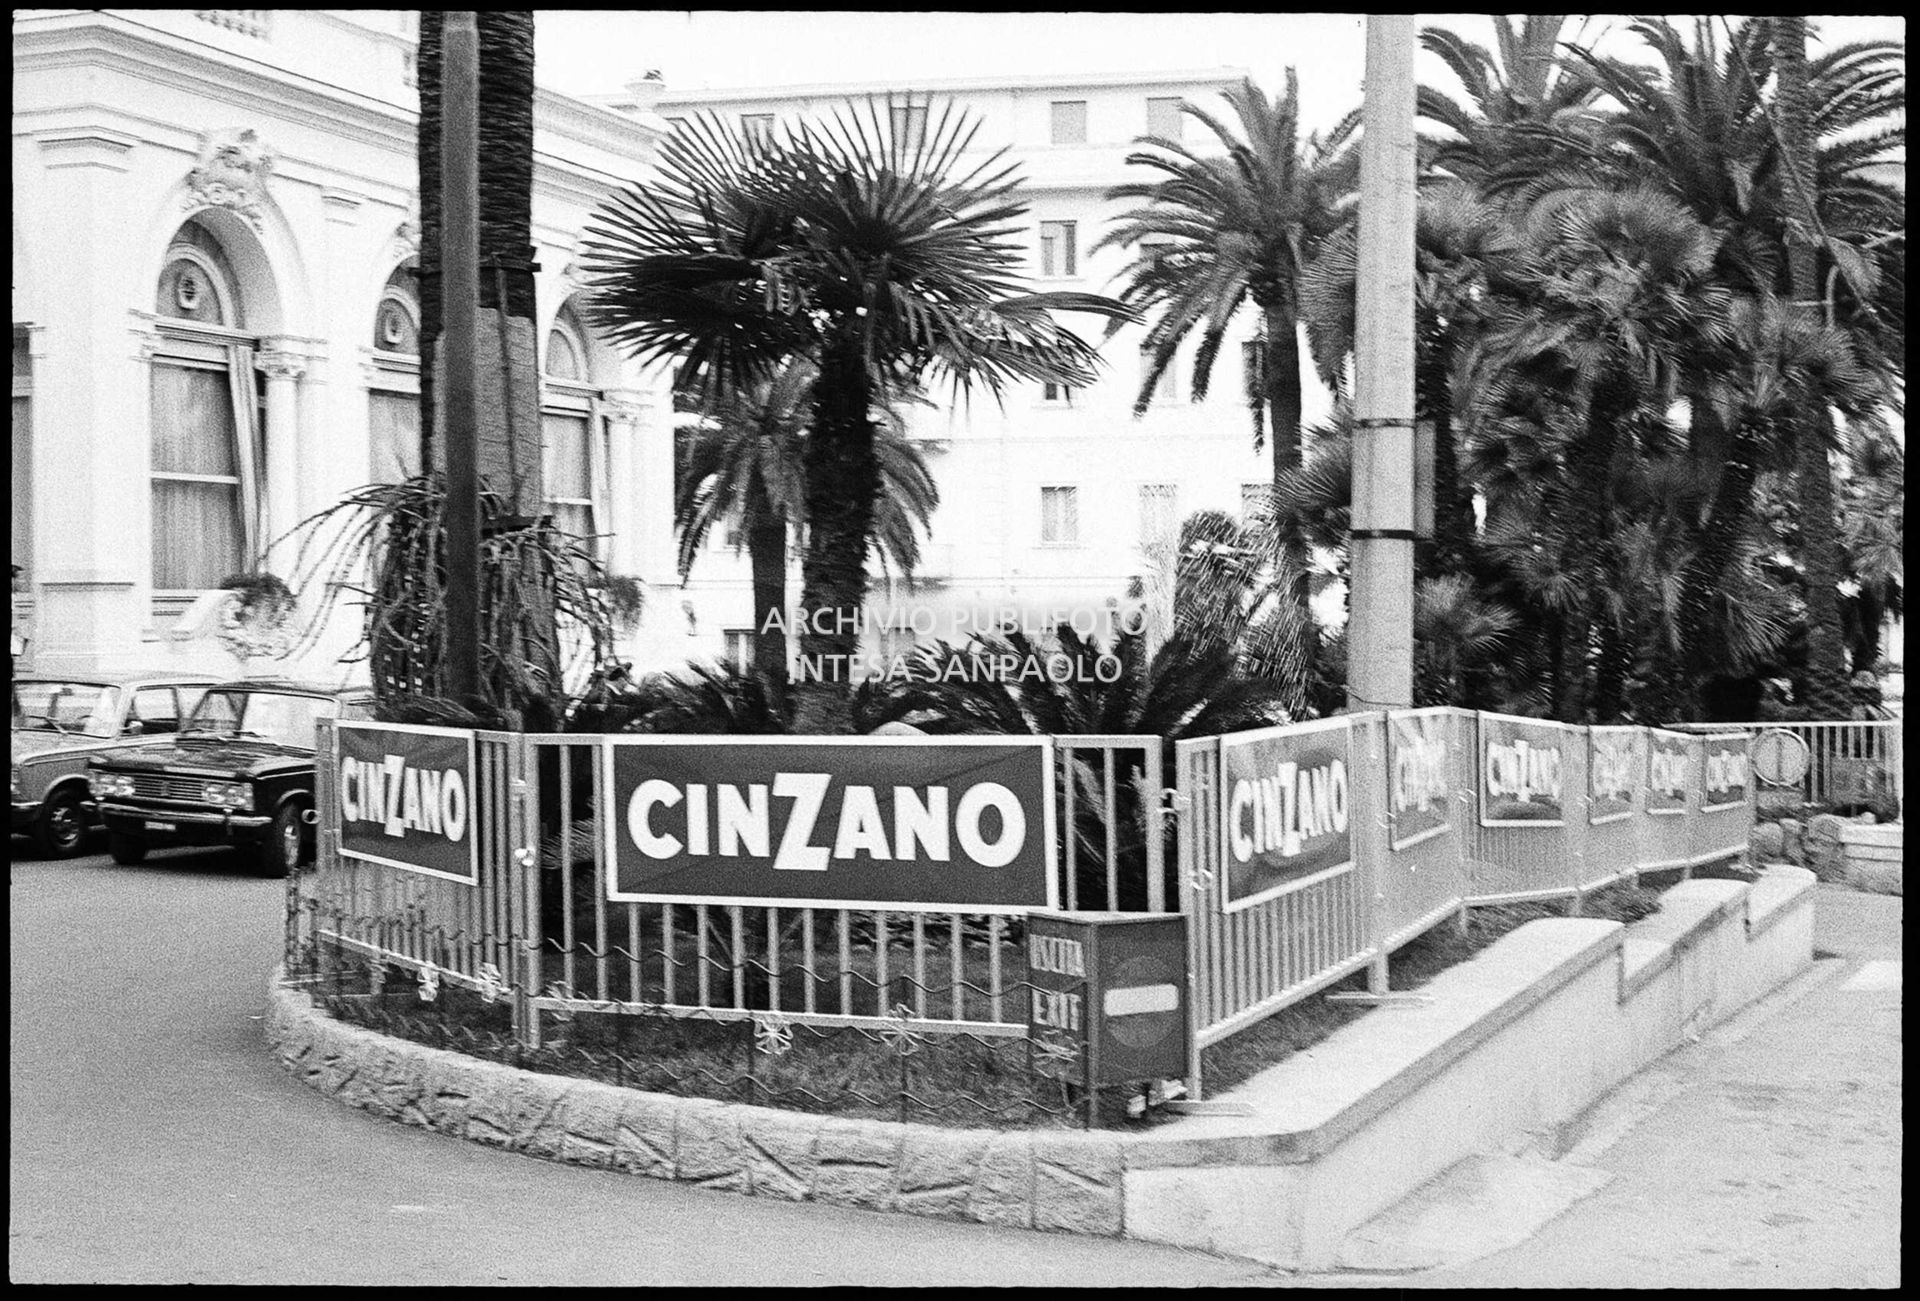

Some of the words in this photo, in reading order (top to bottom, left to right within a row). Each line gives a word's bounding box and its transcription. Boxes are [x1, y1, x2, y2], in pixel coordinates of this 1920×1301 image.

[341, 754, 467, 842] CINZANO
[627, 772, 1027, 868] CINZANO
[1230, 759, 1348, 863] CINZANO
[1031, 988, 1082, 1031] EXIT
